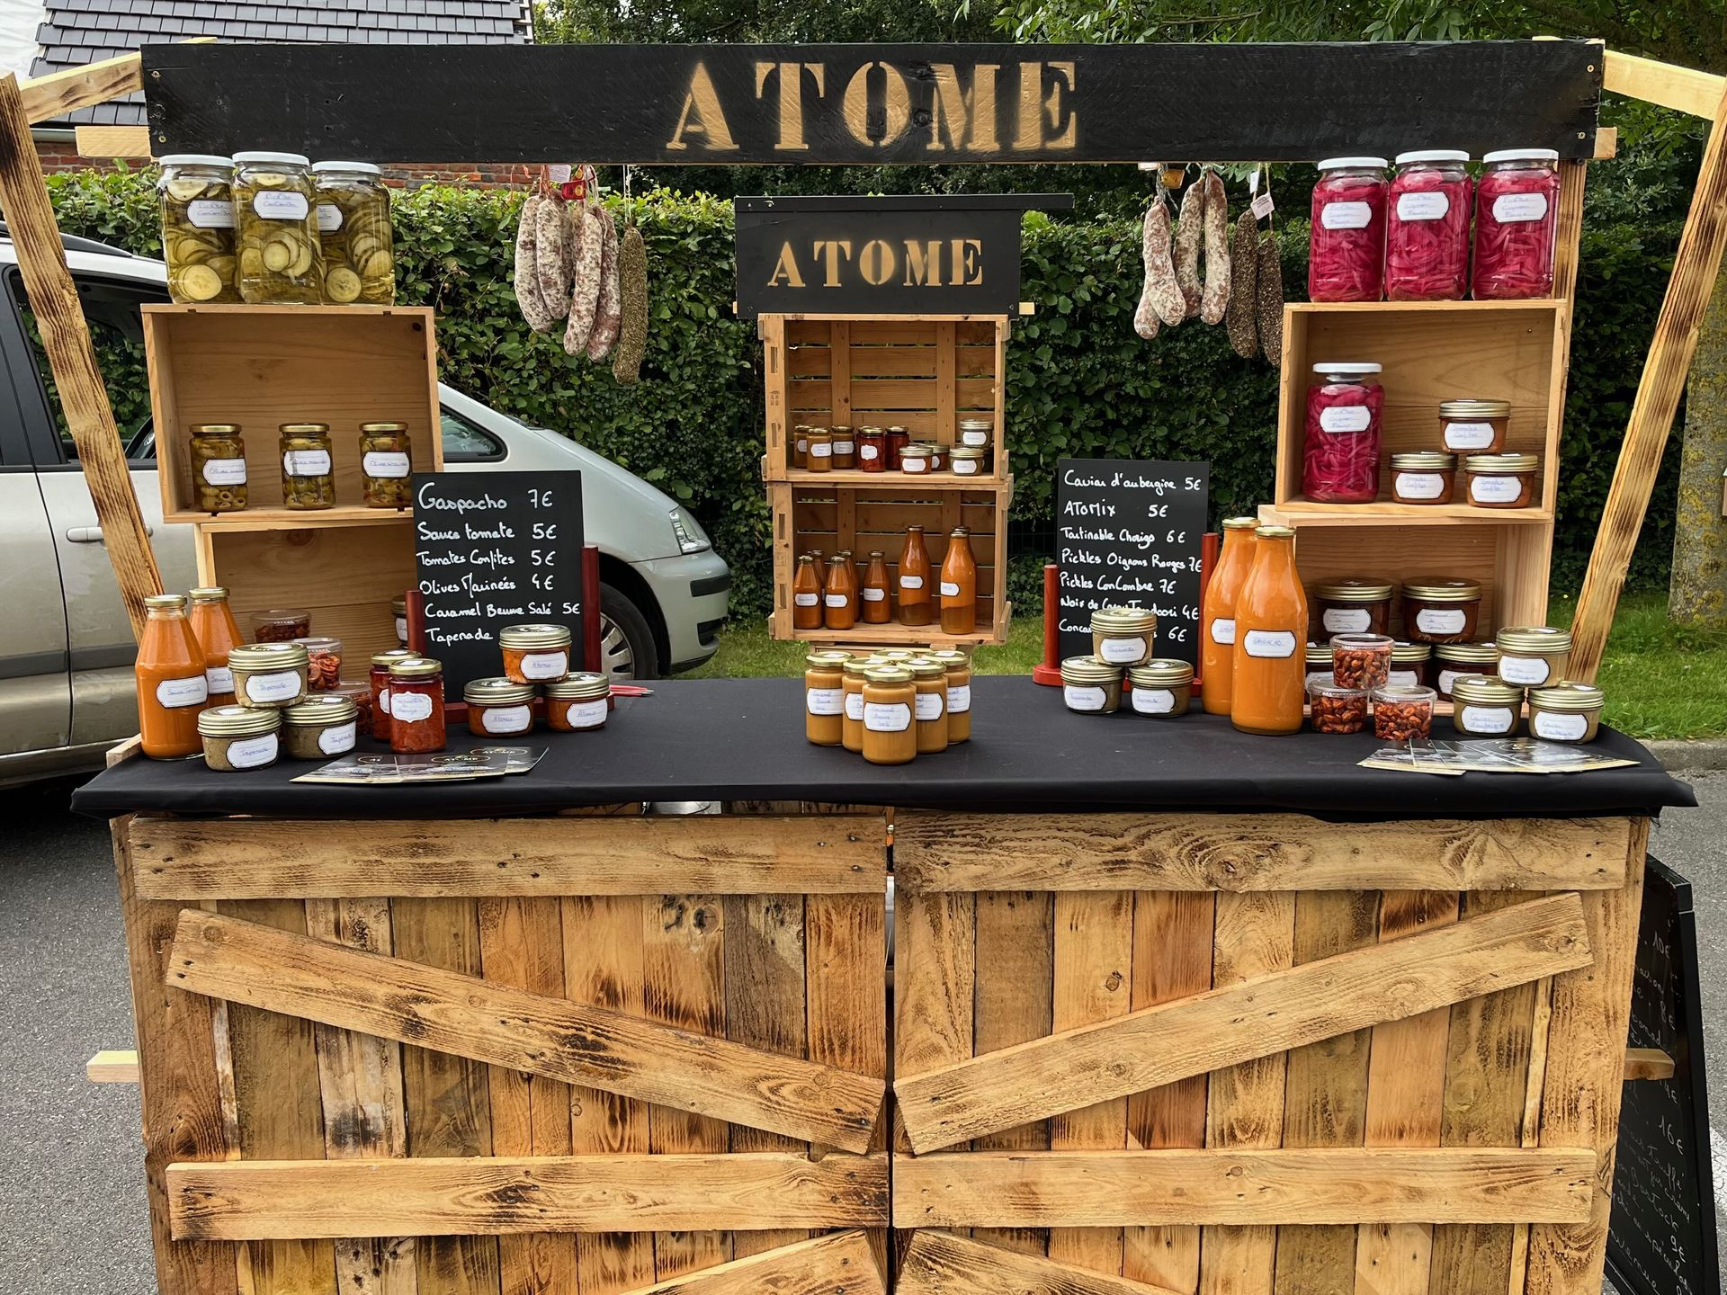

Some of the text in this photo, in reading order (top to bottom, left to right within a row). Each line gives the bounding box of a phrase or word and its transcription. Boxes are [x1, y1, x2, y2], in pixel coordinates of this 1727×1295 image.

[666, 61, 1076, 151] ATOME
[767, 239, 983, 288] ATOME
[1064, 469, 1201, 496] Caviar d'aubergine 5€
[418, 482, 553, 515] Gaspacho 7€
[1148, 504, 1168, 518] 5€
[417, 521, 557, 541] Sauce tomate 5€
[1059, 526, 1116, 541] Tartinable
[1166, 530, 1186, 544] 6€
[416, 548, 556, 570] Tomates Confites 5€
[1061, 547, 1202, 574] Pickles Oignons Rouges 7€
[420, 580, 460, 595] Olives
[531, 573, 554, 590] 4€
[1059, 571, 1094, 588] Pickles
[1159, 579, 1177, 595] 7€
[425, 602, 481, 618] Caramel
[528, 602, 552, 615] Salé
[562, 602, 581, 615] 5€
[1087, 599, 1099, 610] de
[1182, 604, 1199, 620] 4€
[425, 627, 494, 647] Tapenade
[1168, 626, 1188, 642] 6€
[1658, 1114, 1684, 1156] 16€
